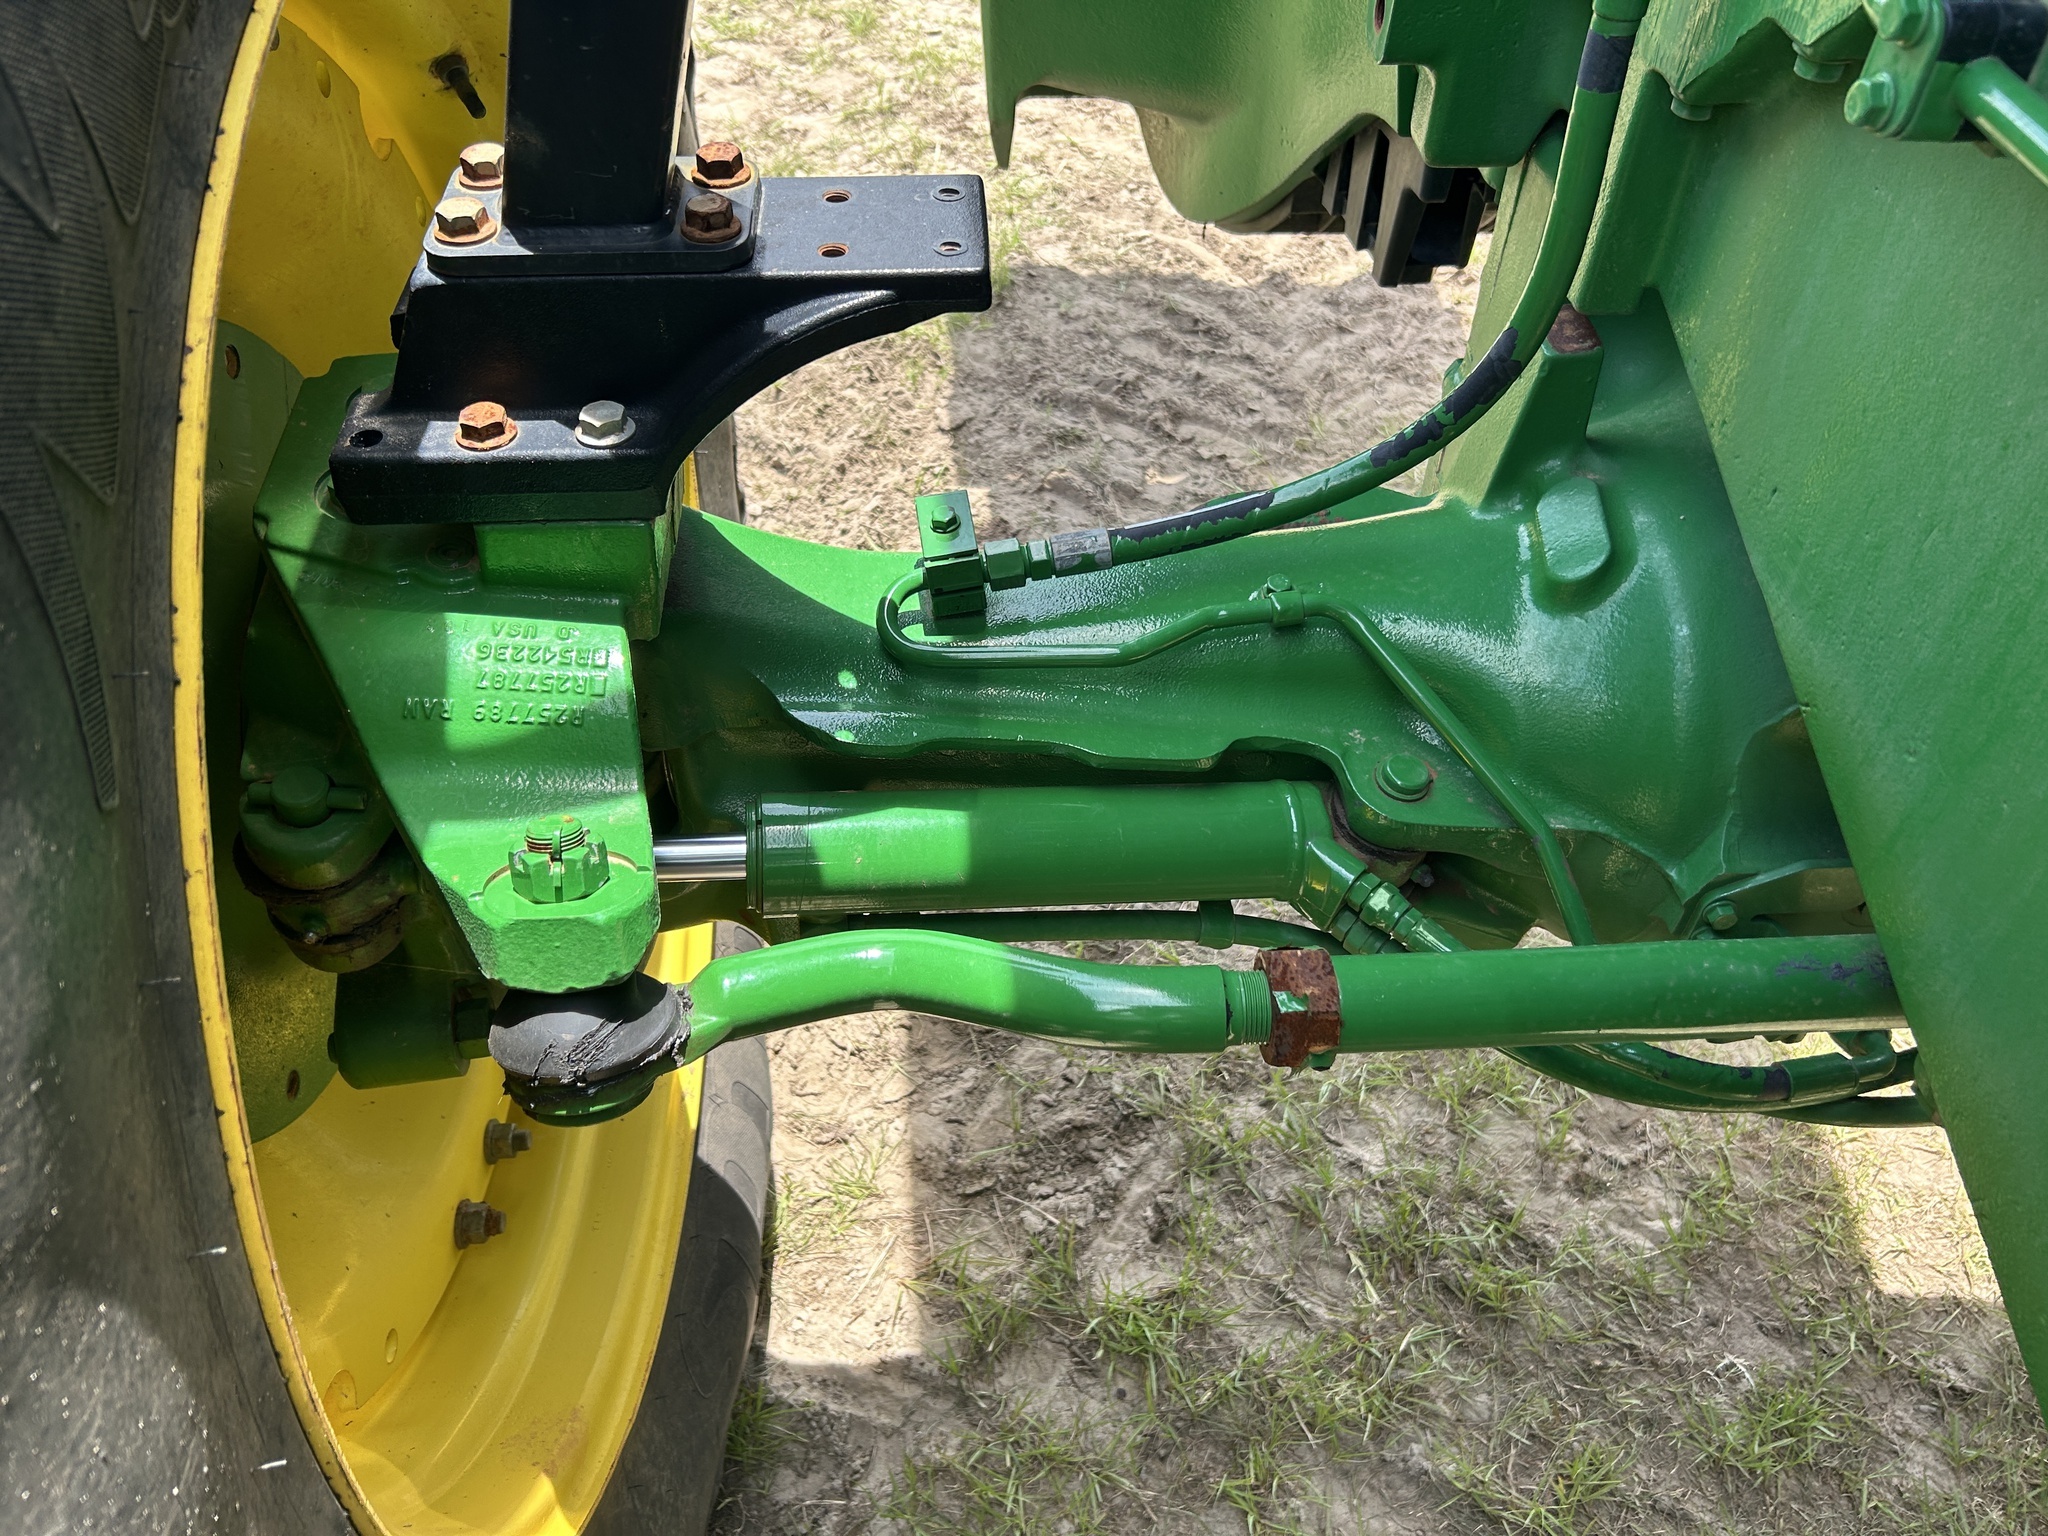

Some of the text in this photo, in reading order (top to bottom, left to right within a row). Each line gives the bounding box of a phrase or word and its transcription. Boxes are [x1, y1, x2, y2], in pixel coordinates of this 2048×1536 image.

[491, 621, 538, 639] USA
[476, 643, 592, 668] R542236
[475, 670, 589, 694] R257787
[472, 699, 585, 727] R257789
